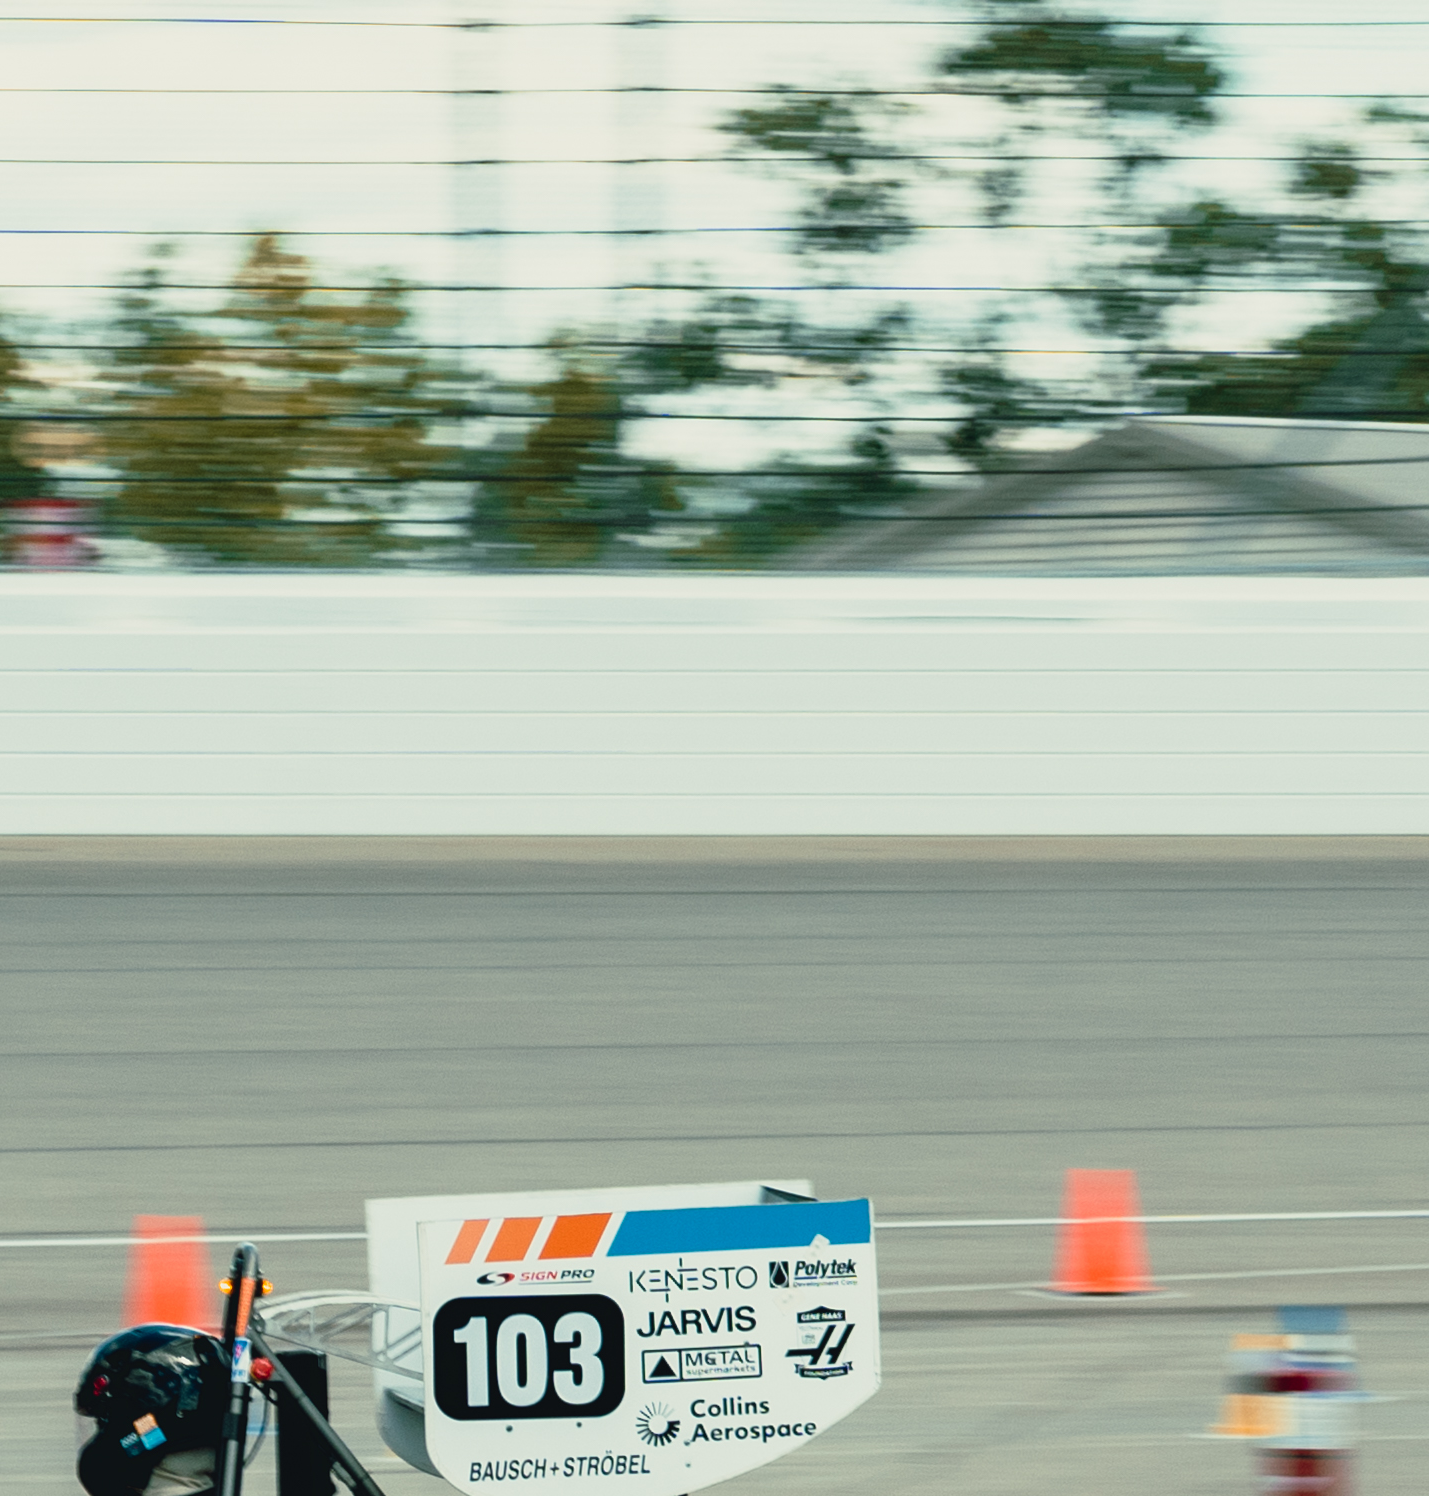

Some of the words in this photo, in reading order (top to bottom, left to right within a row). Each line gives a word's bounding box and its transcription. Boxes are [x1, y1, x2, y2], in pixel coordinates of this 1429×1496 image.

[519, 1270, 558, 1282] SIGN
[560, 1269, 595, 1280] PRO
[794, 1258, 857, 1279] Polytek
[629, 1257, 758, 1303] KENESTO
[636, 1306, 757, 1338] JARVIS
[454, 1311, 604, 1408] 103
[685, 1350, 755, 1367] METAL
[686, 1364, 756, 1377] supermarkets
[690, 1396, 770, 1418] Collins
[691, 1422, 817, 1443] Aerospace
[470, 1458, 547, 1482] BAUSCH
[563, 1450, 651, 1478] STRÖBEL
